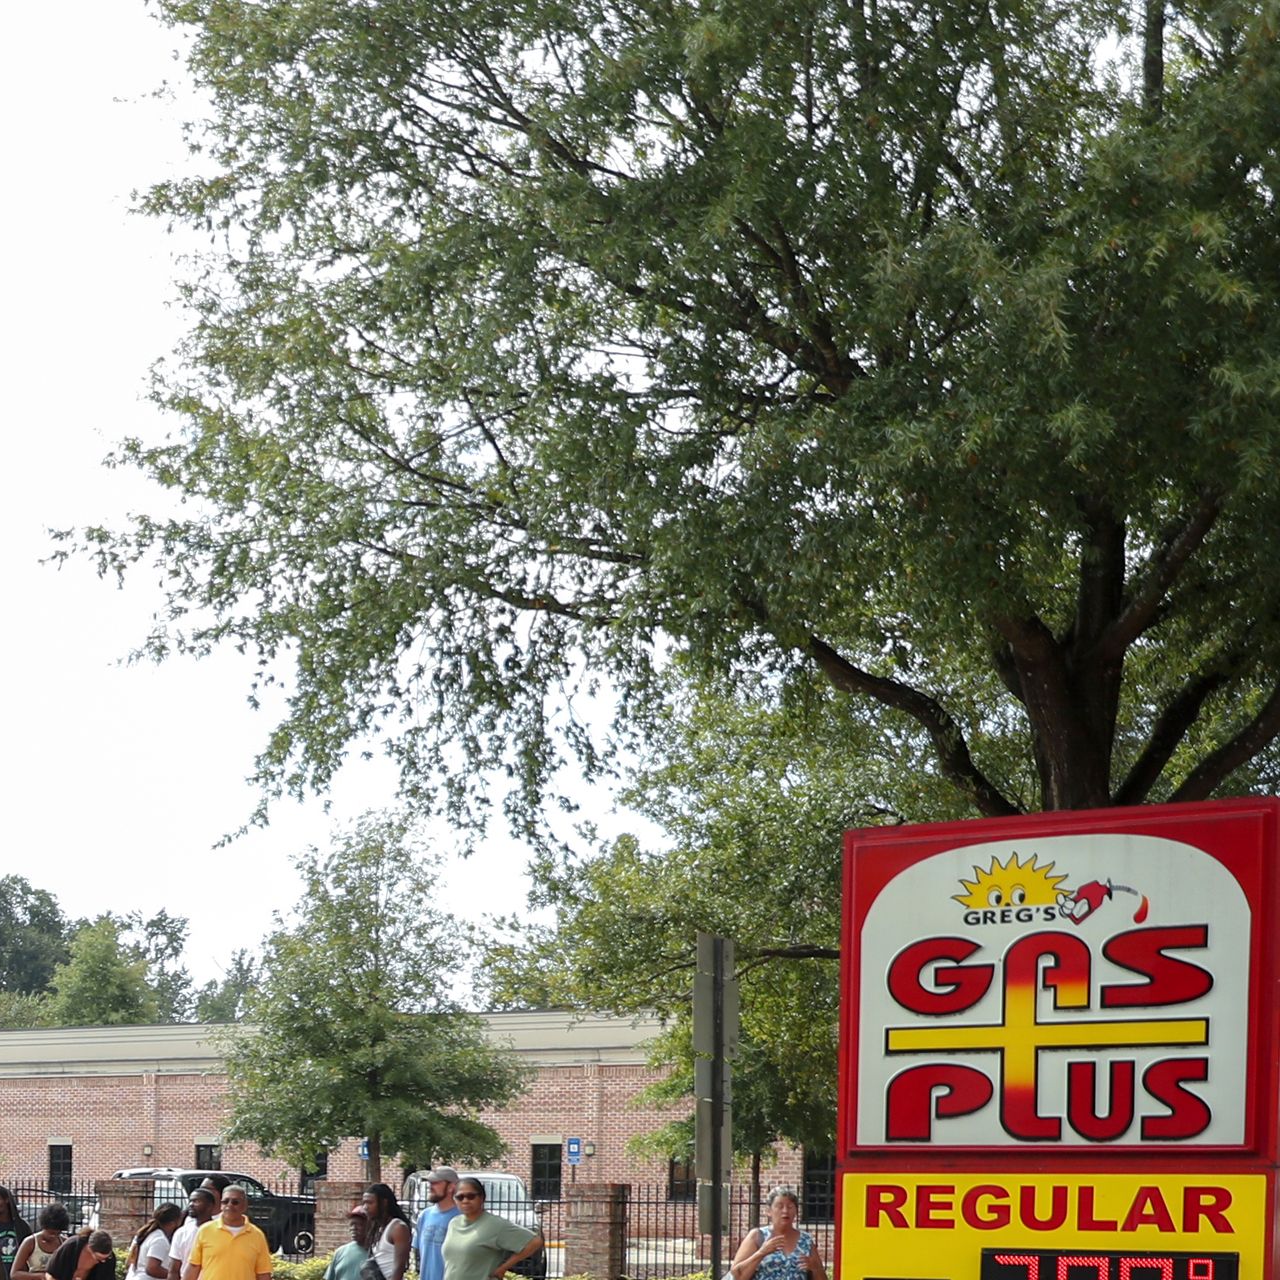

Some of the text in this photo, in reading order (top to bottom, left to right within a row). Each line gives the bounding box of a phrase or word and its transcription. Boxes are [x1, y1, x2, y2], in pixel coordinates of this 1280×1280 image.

[963, 906, 1057, 926] GREG'S
[886, 924, 1215, 1016] GAS
[885, 1056, 1213, 1143] PLUS
[864, 1184, 1236, 1234] REGULAR
